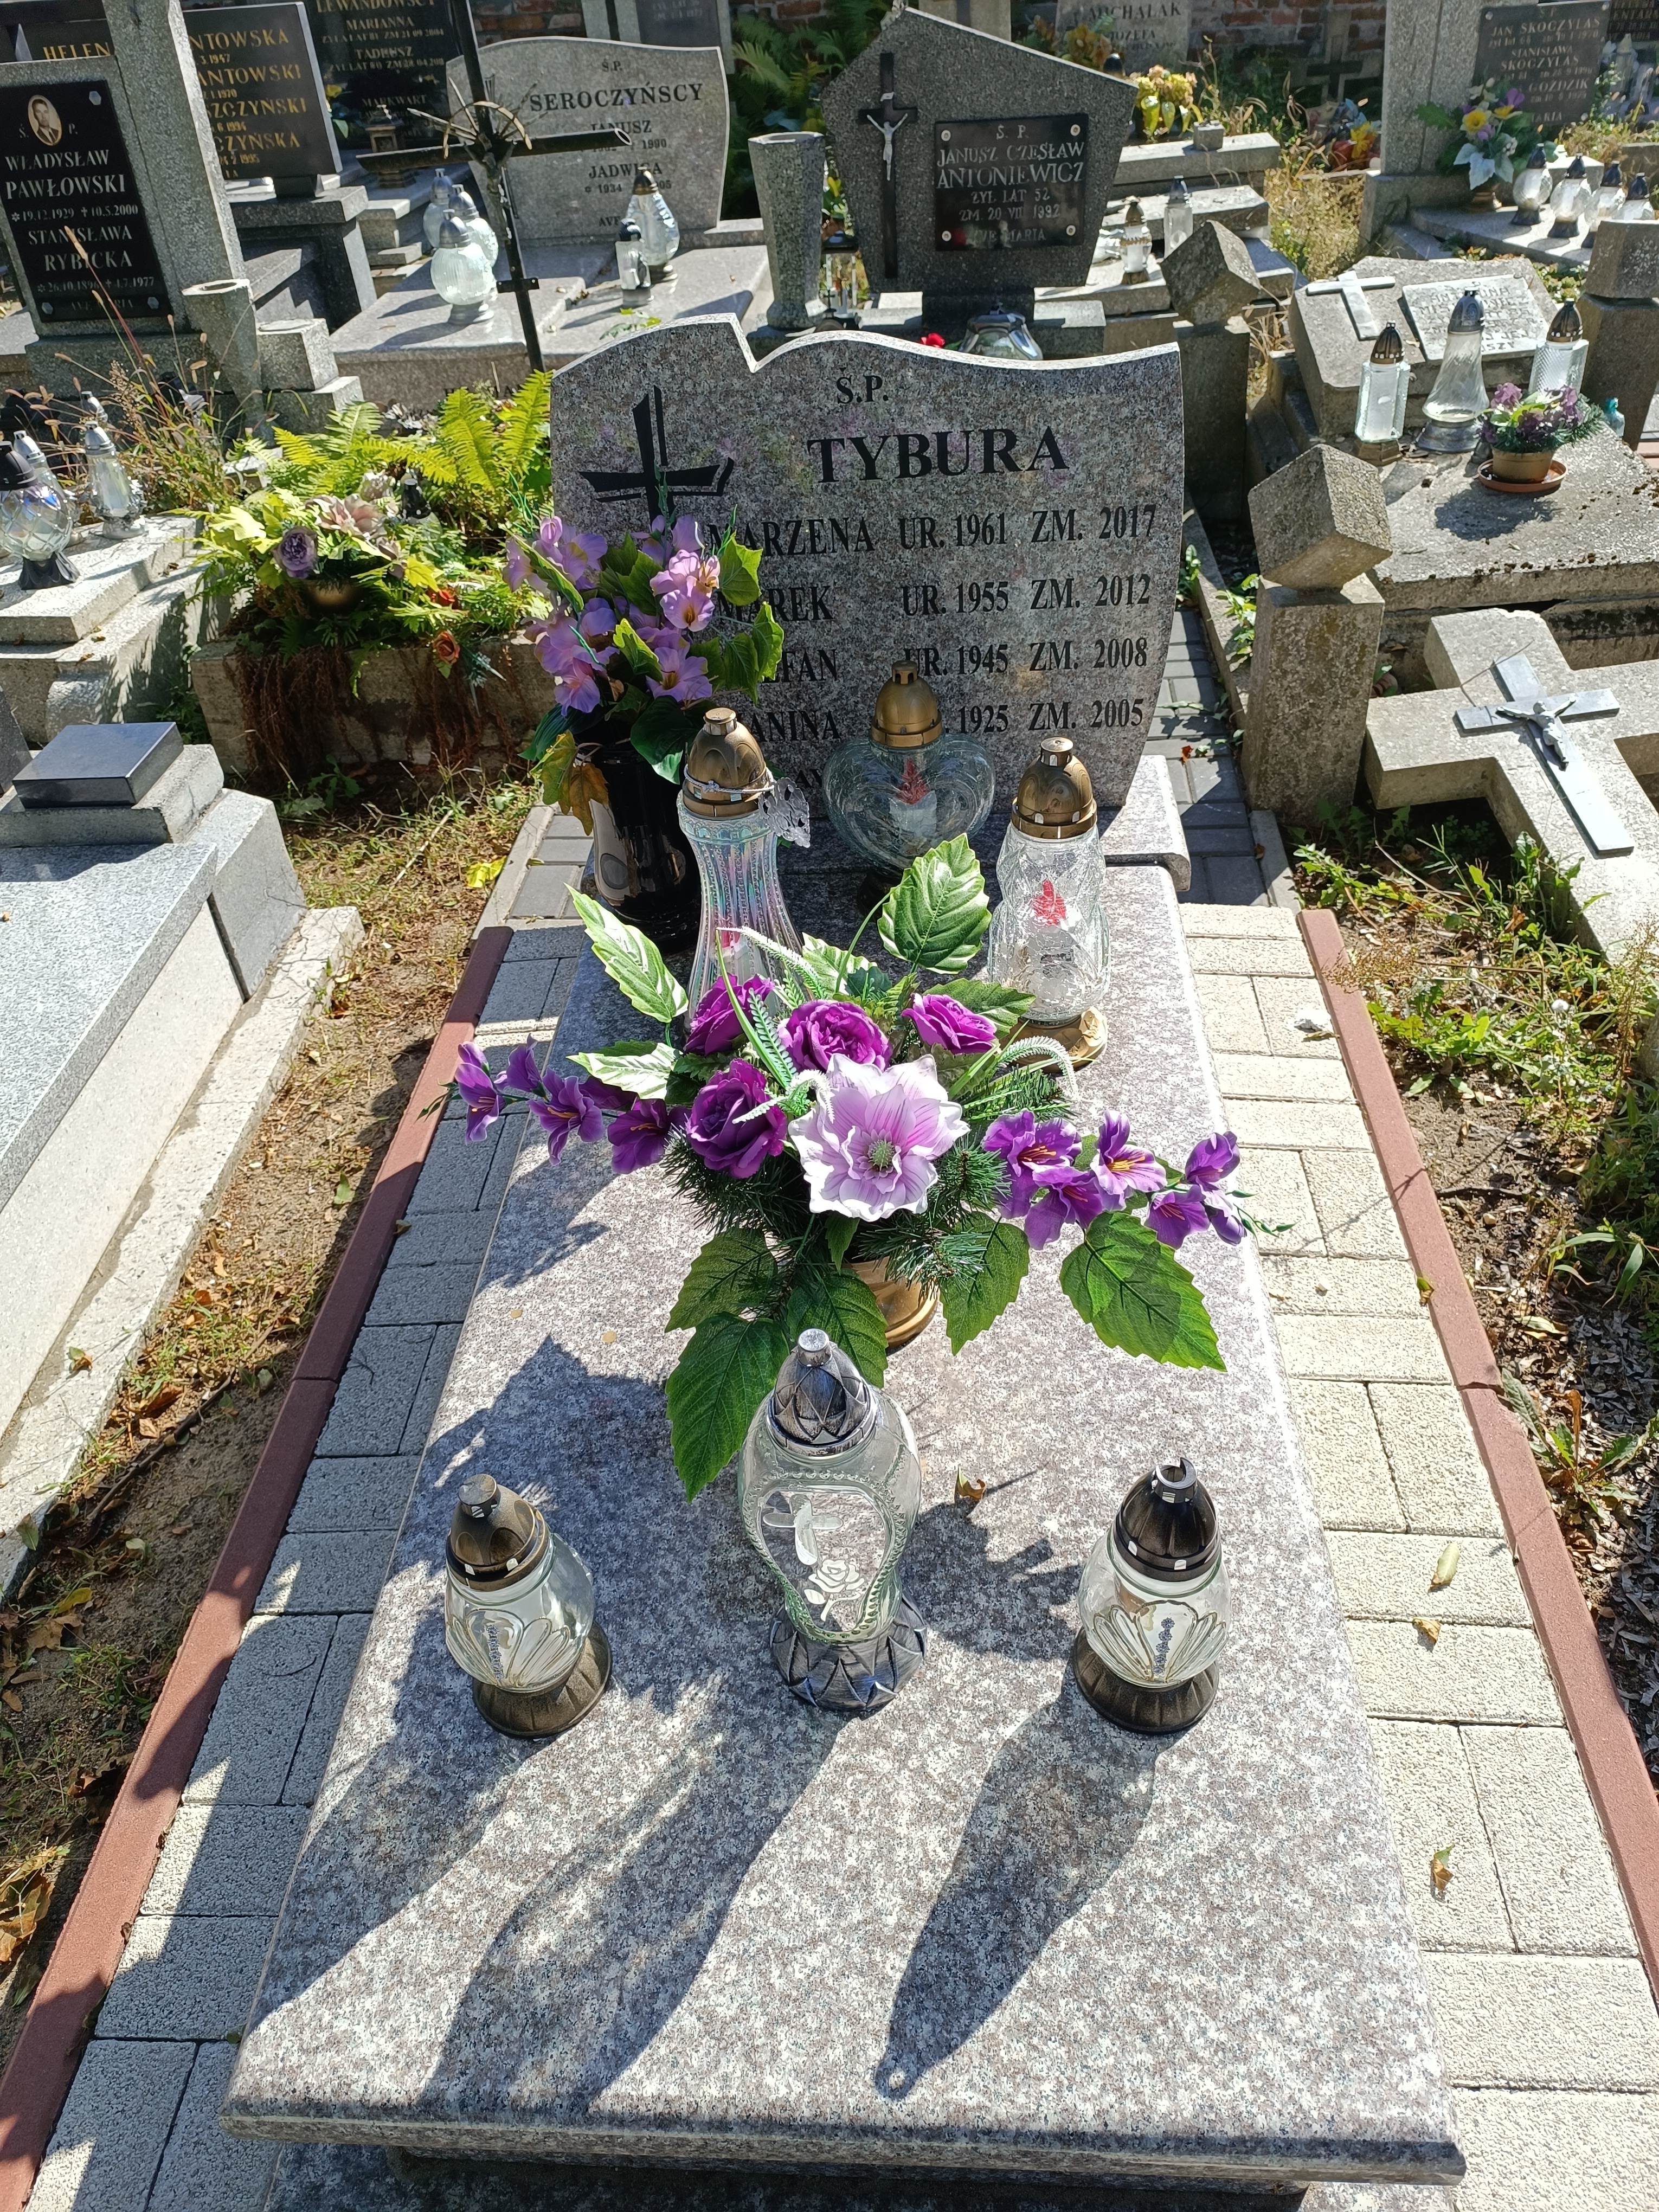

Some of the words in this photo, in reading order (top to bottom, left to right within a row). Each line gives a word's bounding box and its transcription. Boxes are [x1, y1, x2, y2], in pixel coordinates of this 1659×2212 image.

[530, 81, 703, 112] SEROCZYŃSCY
[5, 149, 110, 171] WŁADYSŁAW
[937, 146, 999, 167] JANUSZ
[5, 174, 126, 200] PAWŁOWSKI
[937, 162, 1084, 189] ANTONIEWICZ
[1002, 189, 1027, 203] LAT
[1034, 187, 1050, 202] 52
[23, 207, 75, 221] 19.12.1929
[91, 203, 139, 217] 10.5.2000
[1032, 203, 1060, 219] 1992
[837, 366, 889, 404] Ś.P.
[807, 425, 1070, 484] TYBURA
[707, 516, 876, 557] MARZENA
[898, 516, 945, 550] UR.
[953, 513, 1007, 548] 1961
[1031, 508, 1083, 543] ZM.
[1099, 504, 1157, 540] 2017
[903, 584, 947, 616] UR.
[956, 581, 1009, 614] 1955
[1030, 577, 1081, 610] ZM.
[1095, 574, 1151, 607] 2012
[904, 647, 948, 677] UR.
[956, 644, 1008, 676] 1945
[1030, 640, 1079, 672] ZM.
[1094, 637, 1148, 669] 2008
[737, 709, 841, 742] ANINA
[959, 704, 1009, 735] 1925
[1028, 701, 1076, 731] ZM.
[1091, 698, 1144, 729] 2005
